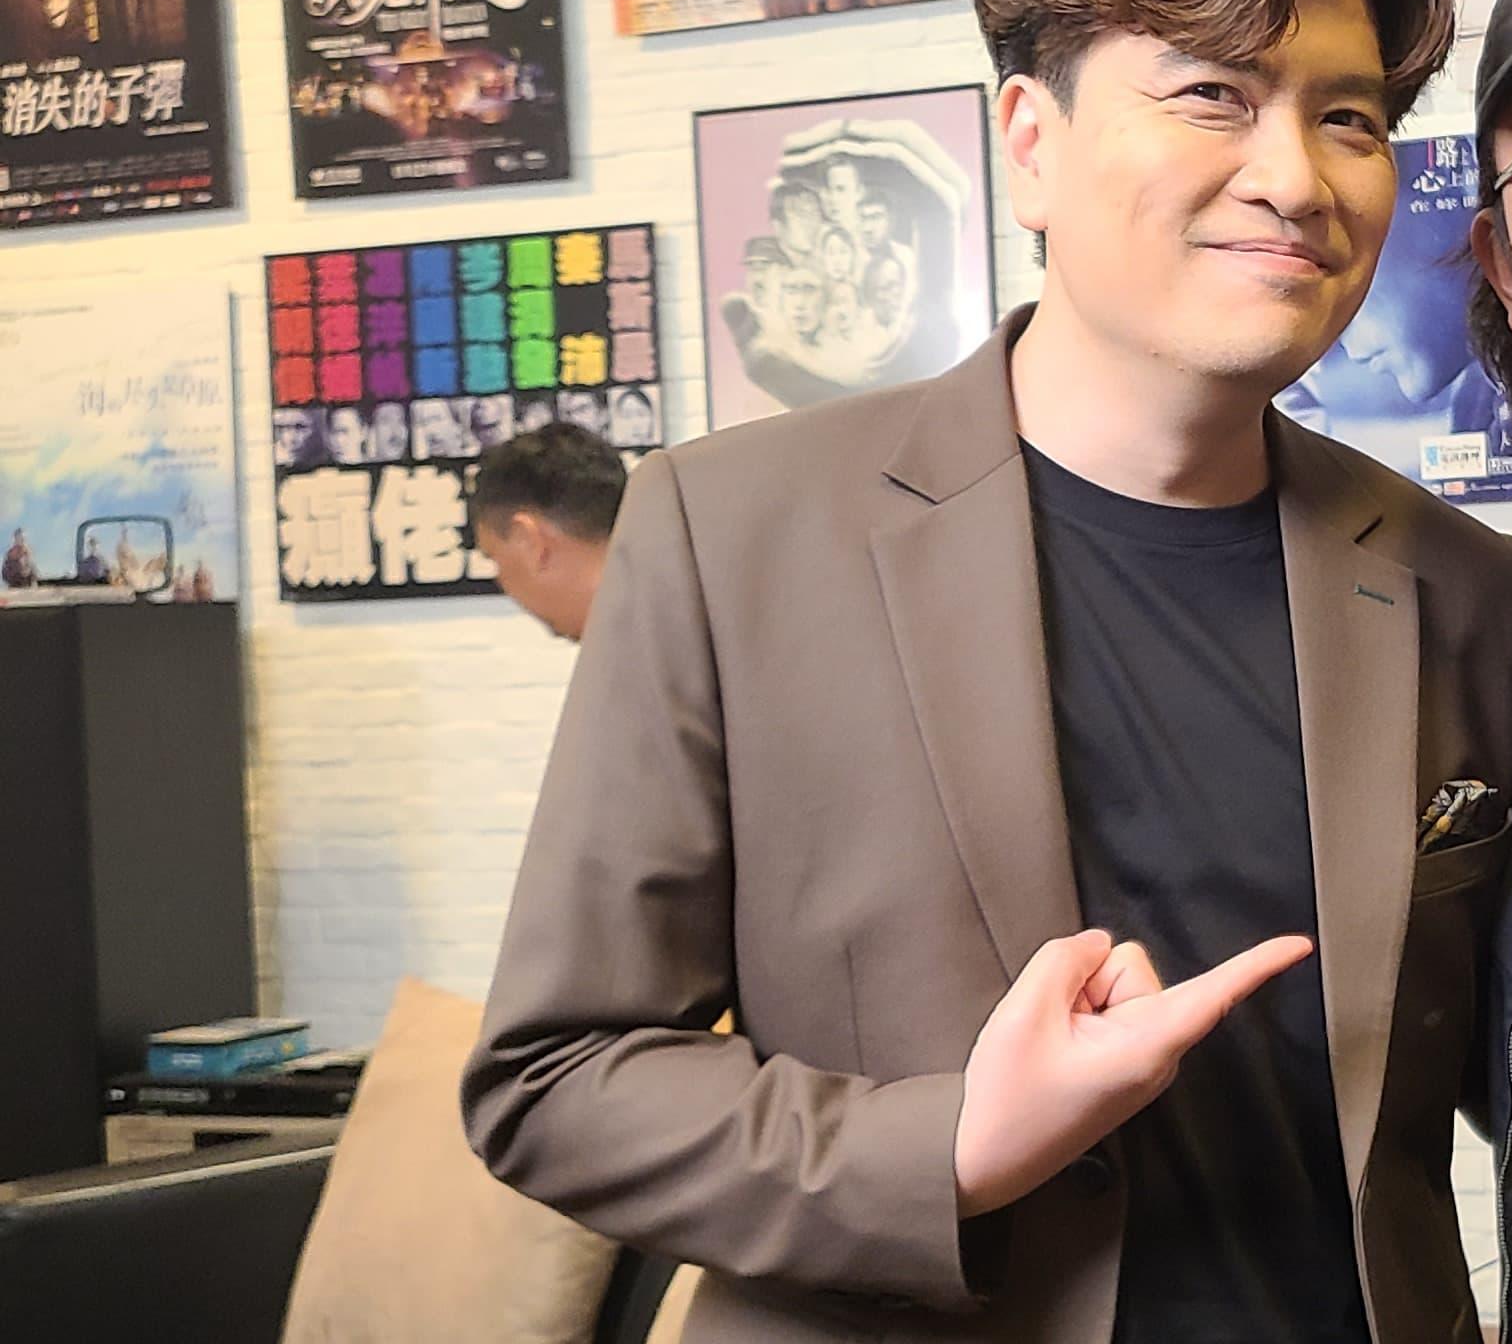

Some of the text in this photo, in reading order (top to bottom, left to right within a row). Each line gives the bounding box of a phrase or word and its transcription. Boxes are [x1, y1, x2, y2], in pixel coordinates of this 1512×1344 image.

[2, 58, 187, 137] 消失的子彈
